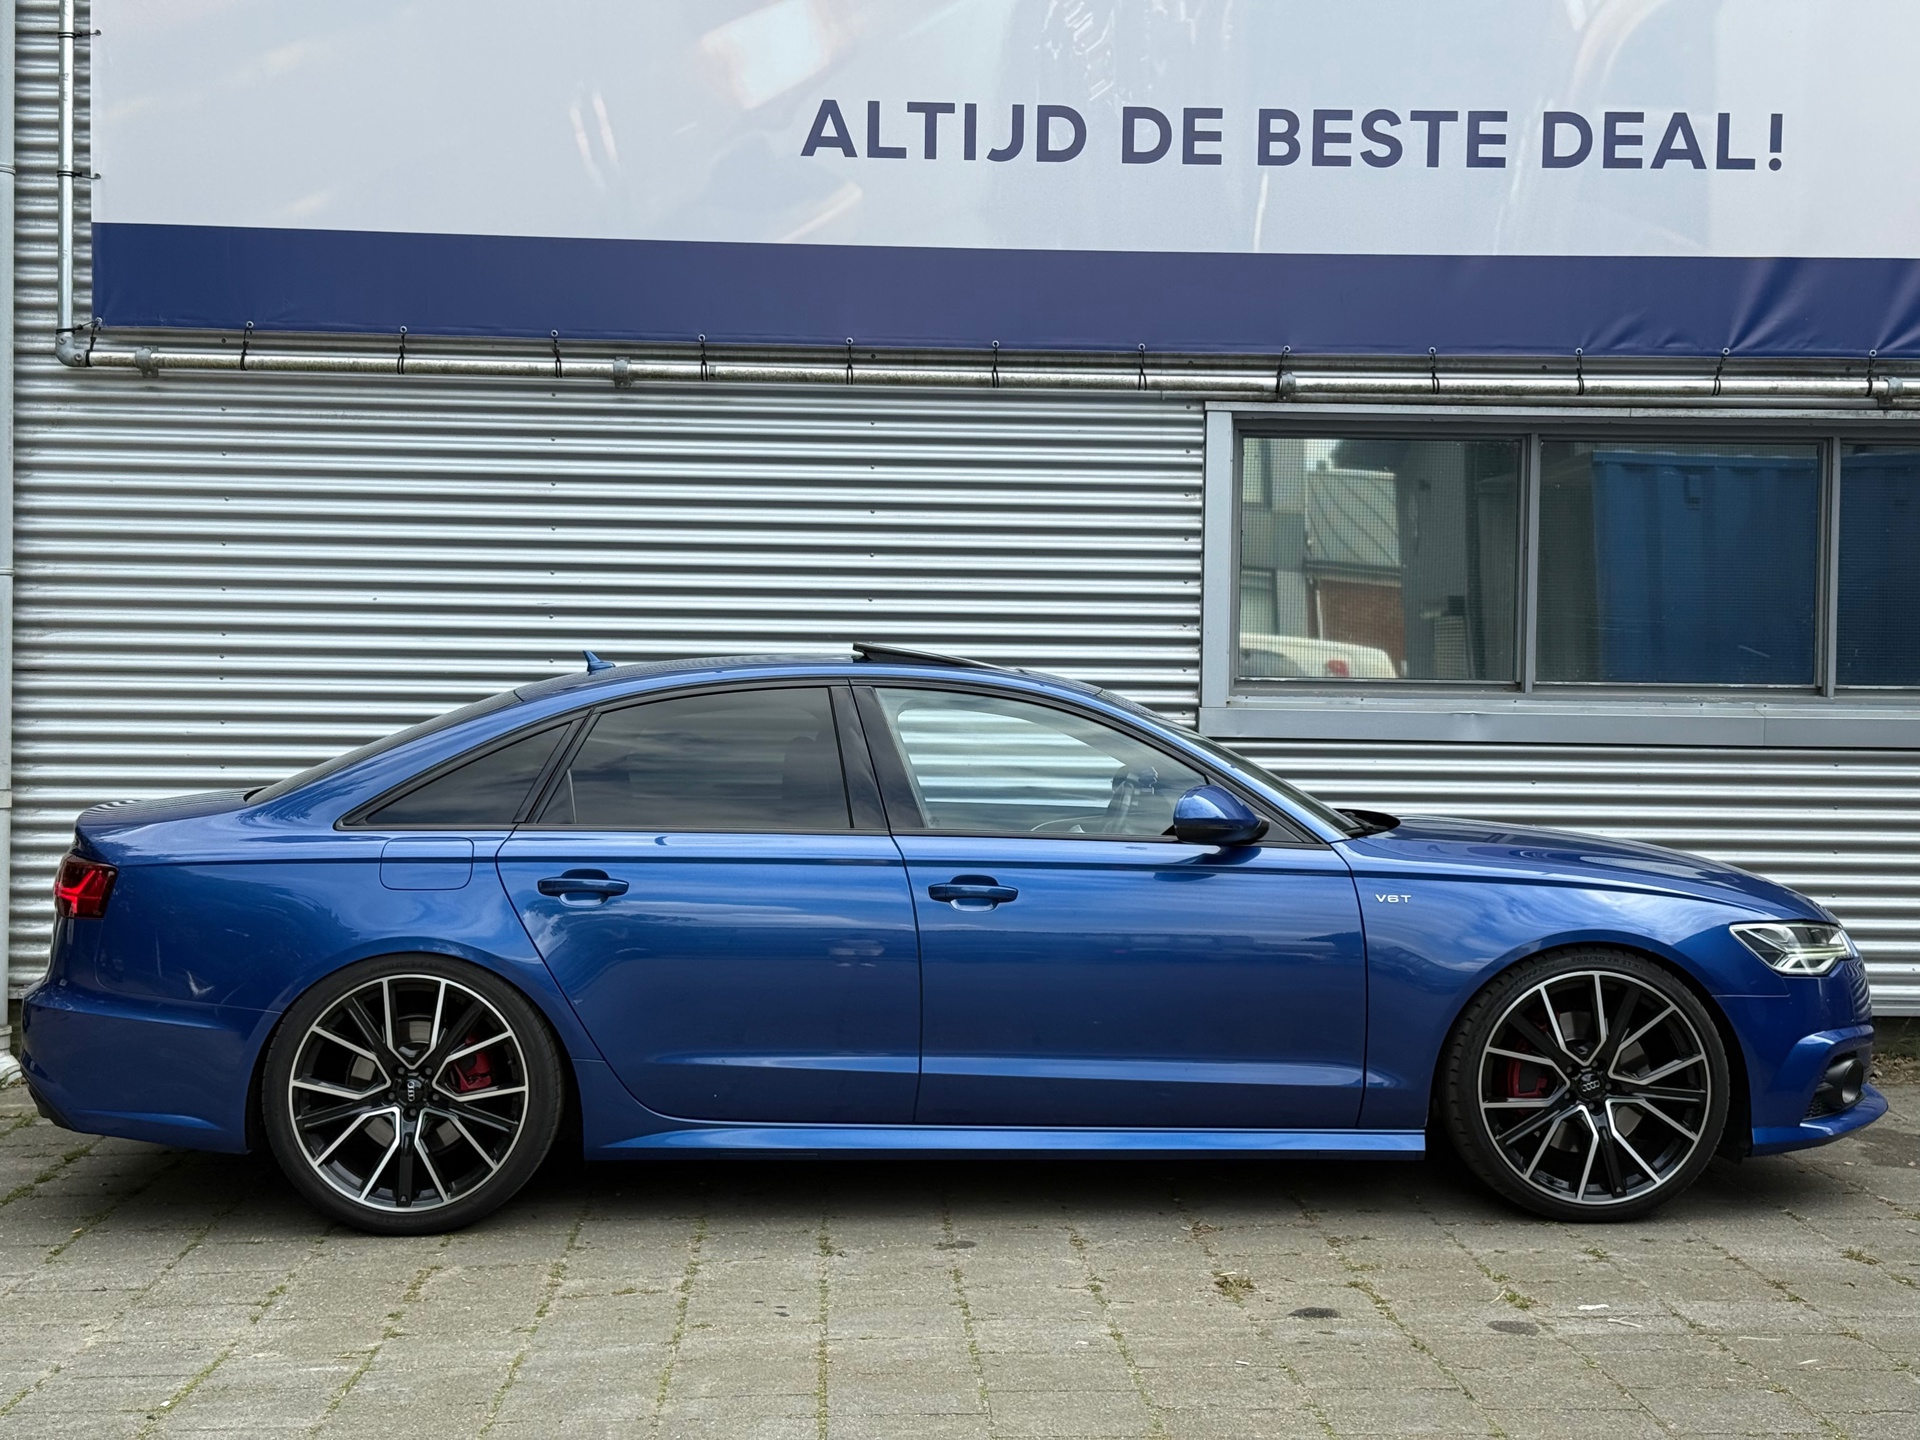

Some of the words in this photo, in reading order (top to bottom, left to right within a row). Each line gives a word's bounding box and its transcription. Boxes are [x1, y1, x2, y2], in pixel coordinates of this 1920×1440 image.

[800, 99, 1087, 163] ALTIJD
[1121, 106, 1223, 165] DE
[1257, 108, 1508, 169] BESTE
[1541, 111, 1783, 171] DEAL!
[1375, 894, 1412, 903] V6T
